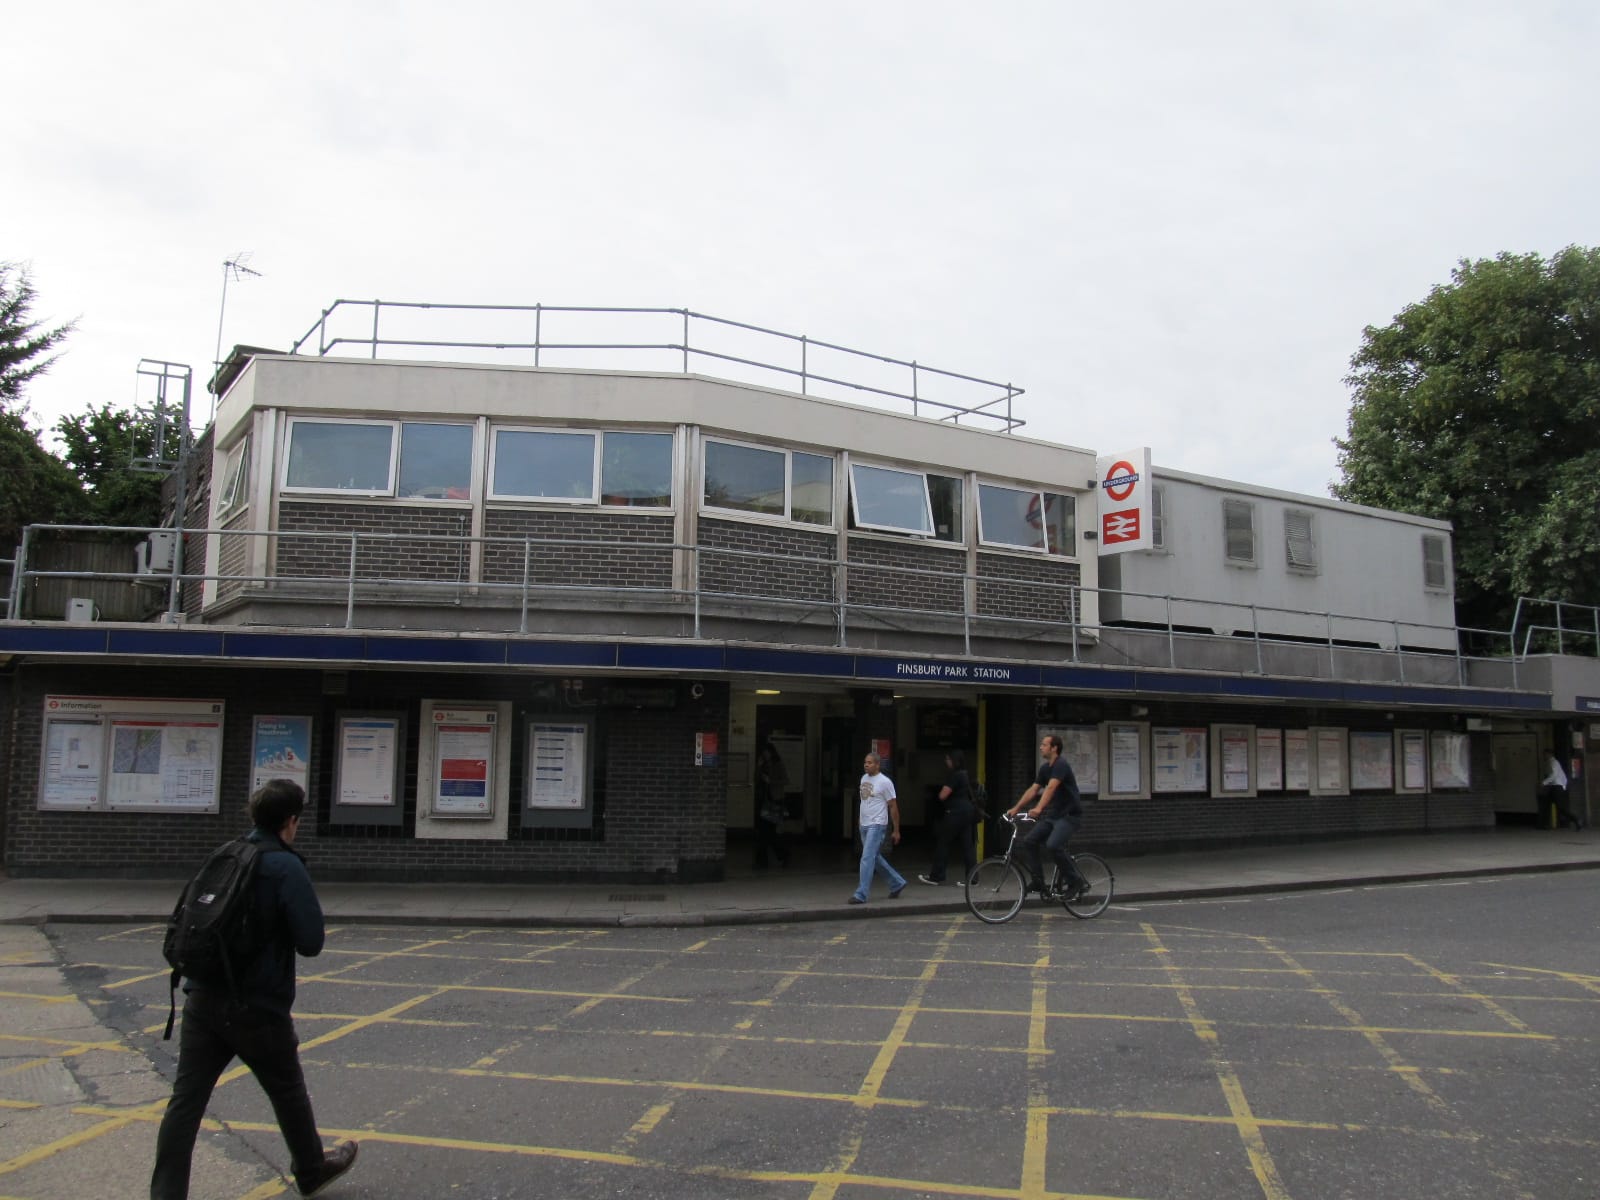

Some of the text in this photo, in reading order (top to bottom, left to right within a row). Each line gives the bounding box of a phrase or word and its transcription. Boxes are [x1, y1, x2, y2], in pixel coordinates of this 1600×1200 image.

[1103, 474, 1138, 488] UNDERGROUND
[897, 663, 1010, 679] FINSBURY PARK STATION
